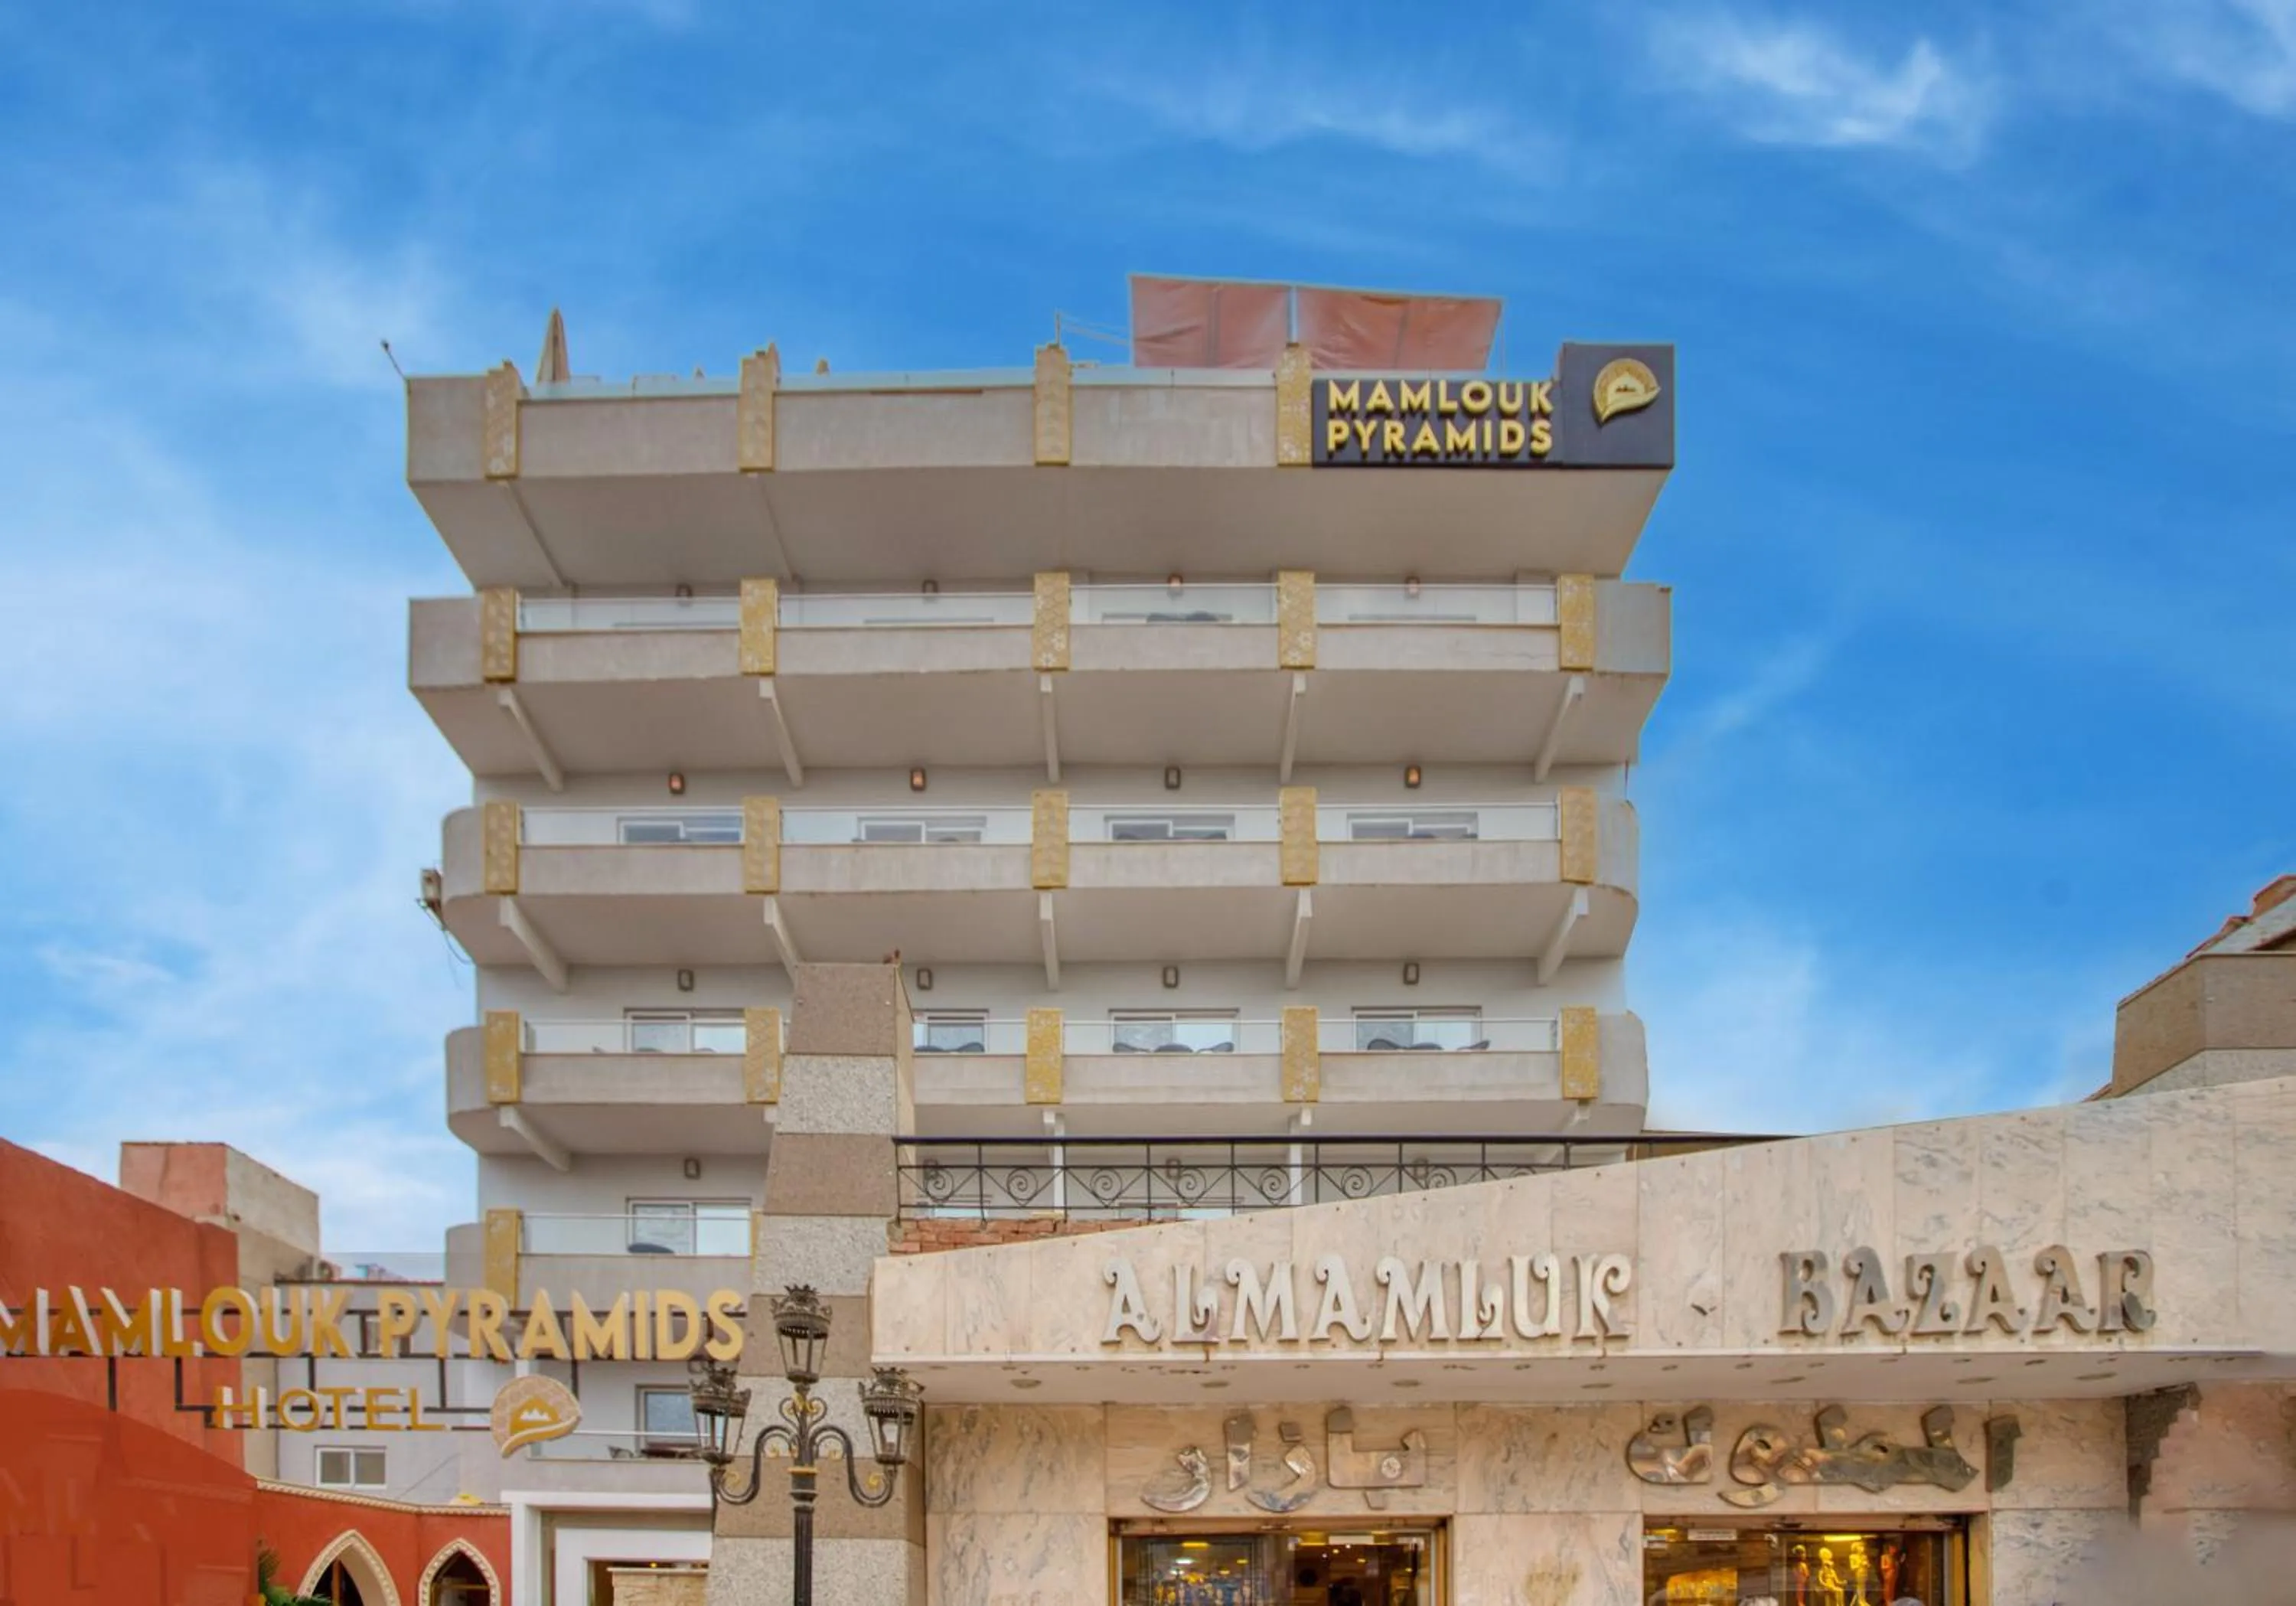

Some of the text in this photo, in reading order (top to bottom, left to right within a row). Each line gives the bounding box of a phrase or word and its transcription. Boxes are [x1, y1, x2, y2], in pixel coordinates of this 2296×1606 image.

[1327, 379, 1554, 416] MAMLOUK
[1326, 419, 1553, 457] PYRAMIDS
[0, 1286, 746, 1363] MAMLOUK PYRAMIDS
[1100, 1244, 2157, 1345] ALMAMLUK BAZAAR
[214, 1386, 452, 1431] HOTEL
[1140, 1405, 1429, 1513] بازار
